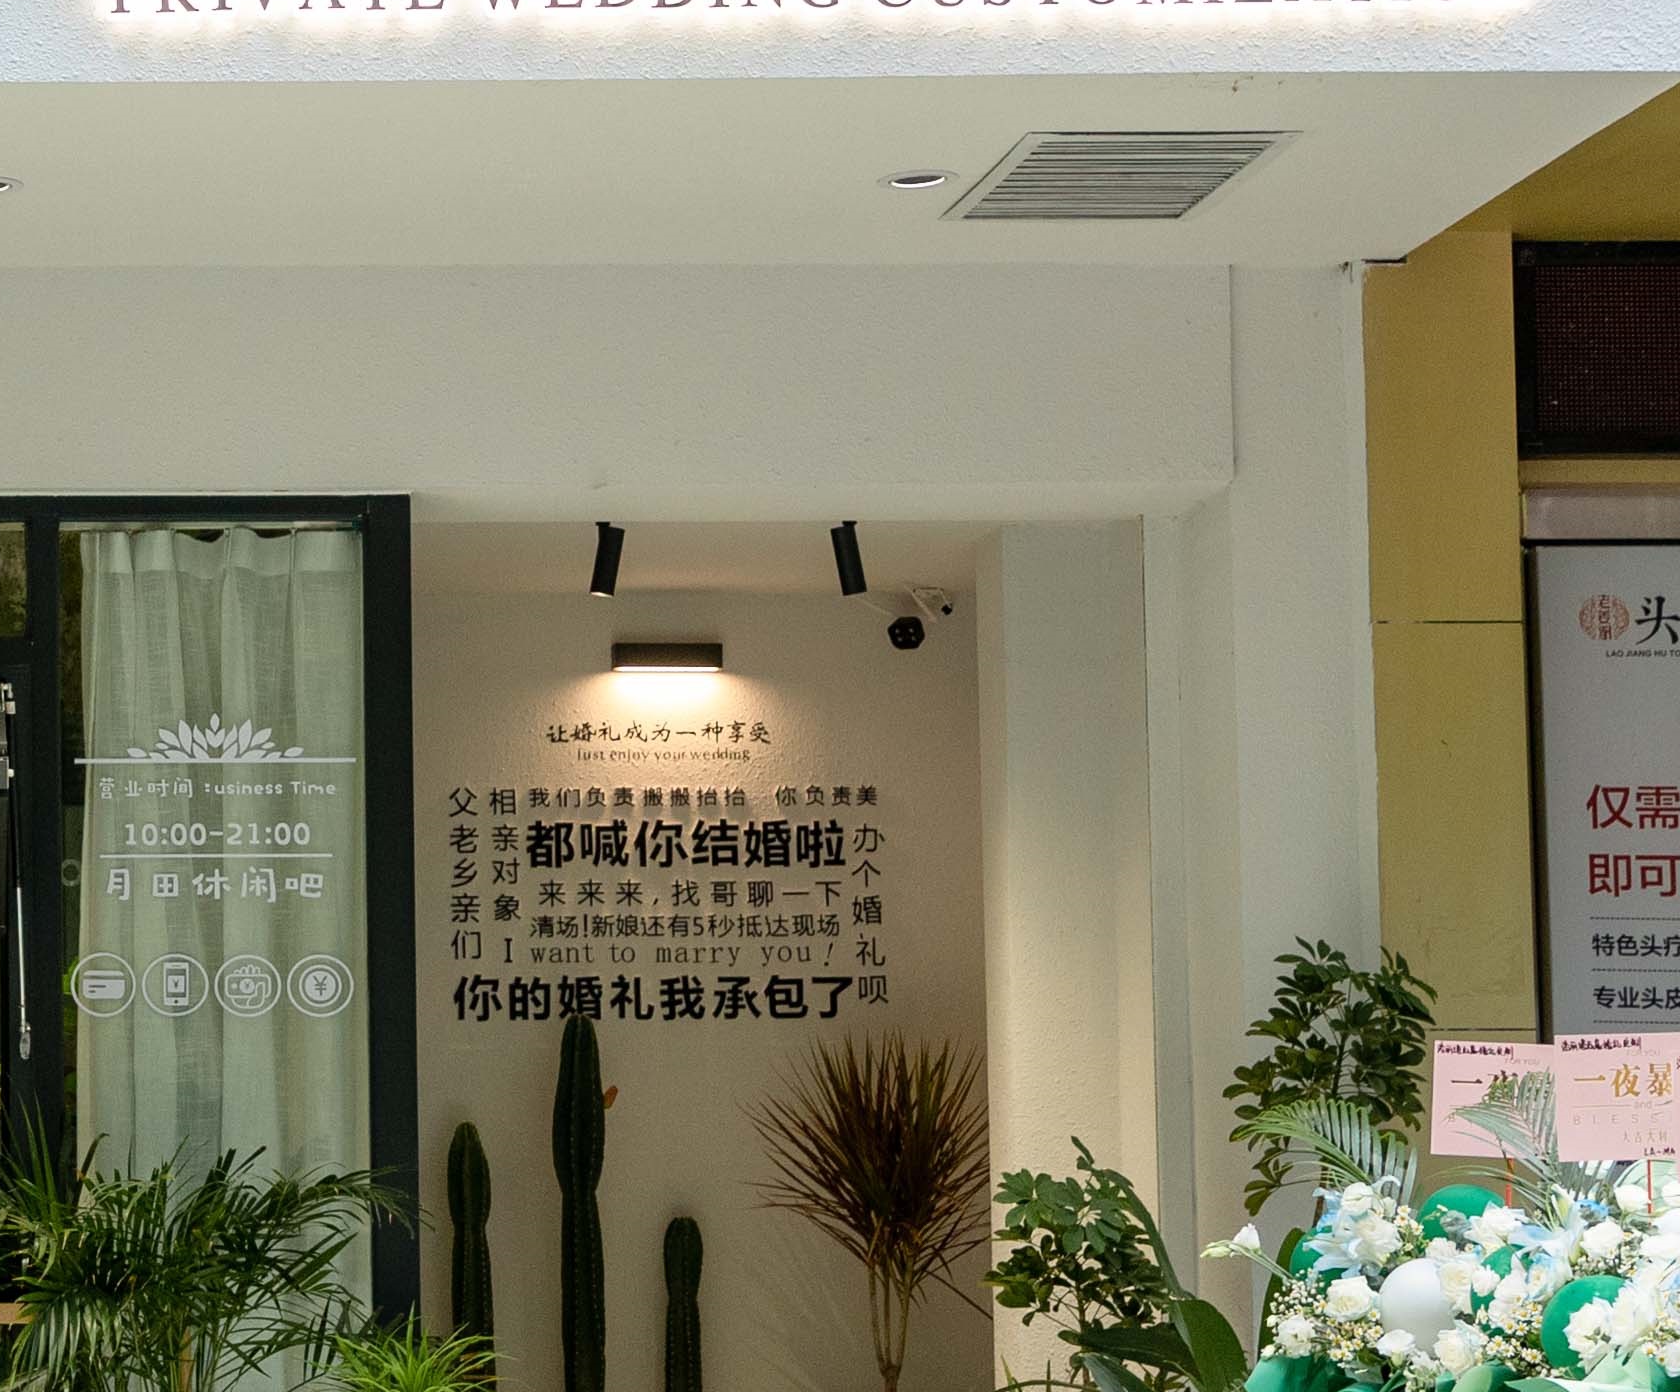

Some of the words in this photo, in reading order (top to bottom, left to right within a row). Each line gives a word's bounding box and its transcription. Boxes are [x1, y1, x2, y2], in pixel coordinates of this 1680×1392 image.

[545, 720, 773, 745] 让婚礼成为一种享受
[290, 781, 337, 795] Time
[125, 822, 311, 846] 10:00-21:00
[526, 819, 846, 868] 都喊你结婚啦
[449, 786, 482, 962] 父老乡亲们
[489, 788, 521, 923] 相亲对象
[107, 866, 324, 903] 月田休闲吧
[851, 823, 889, 1006] 办个婚礼呗
[504, 939, 514, 963] I
[531, 941, 595, 964] want
[609, 943, 636, 964] to
[656, 943, 741, 966] marry
[454, 975, 853, 1022] 你的婚礼我承包了
